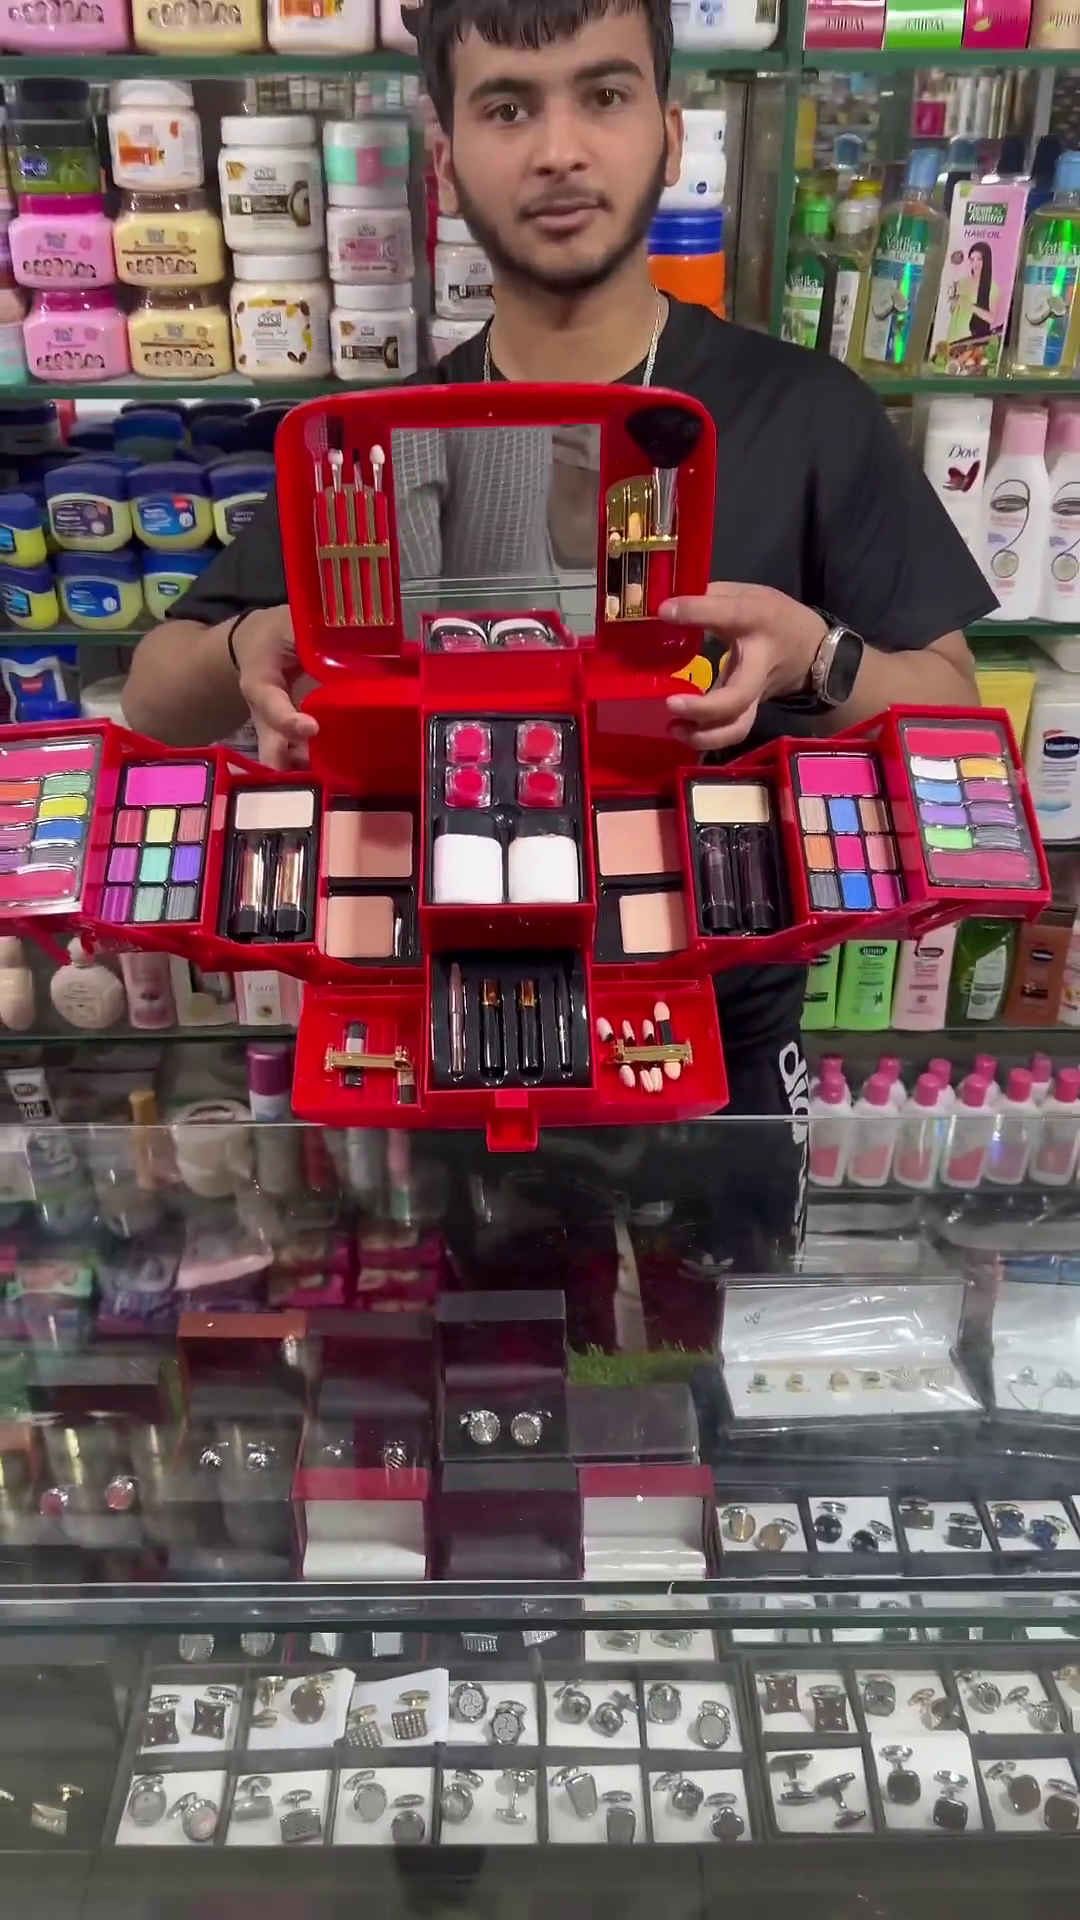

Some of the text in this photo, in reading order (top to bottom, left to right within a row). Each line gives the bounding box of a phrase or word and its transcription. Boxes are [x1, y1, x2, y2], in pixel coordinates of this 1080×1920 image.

[987, 230, 1002, 240] OIL
[886, 234, 921, 252] Vatika
[789, 275, 818, 289] Vatika
[948, 444, 980, 458] Dove
